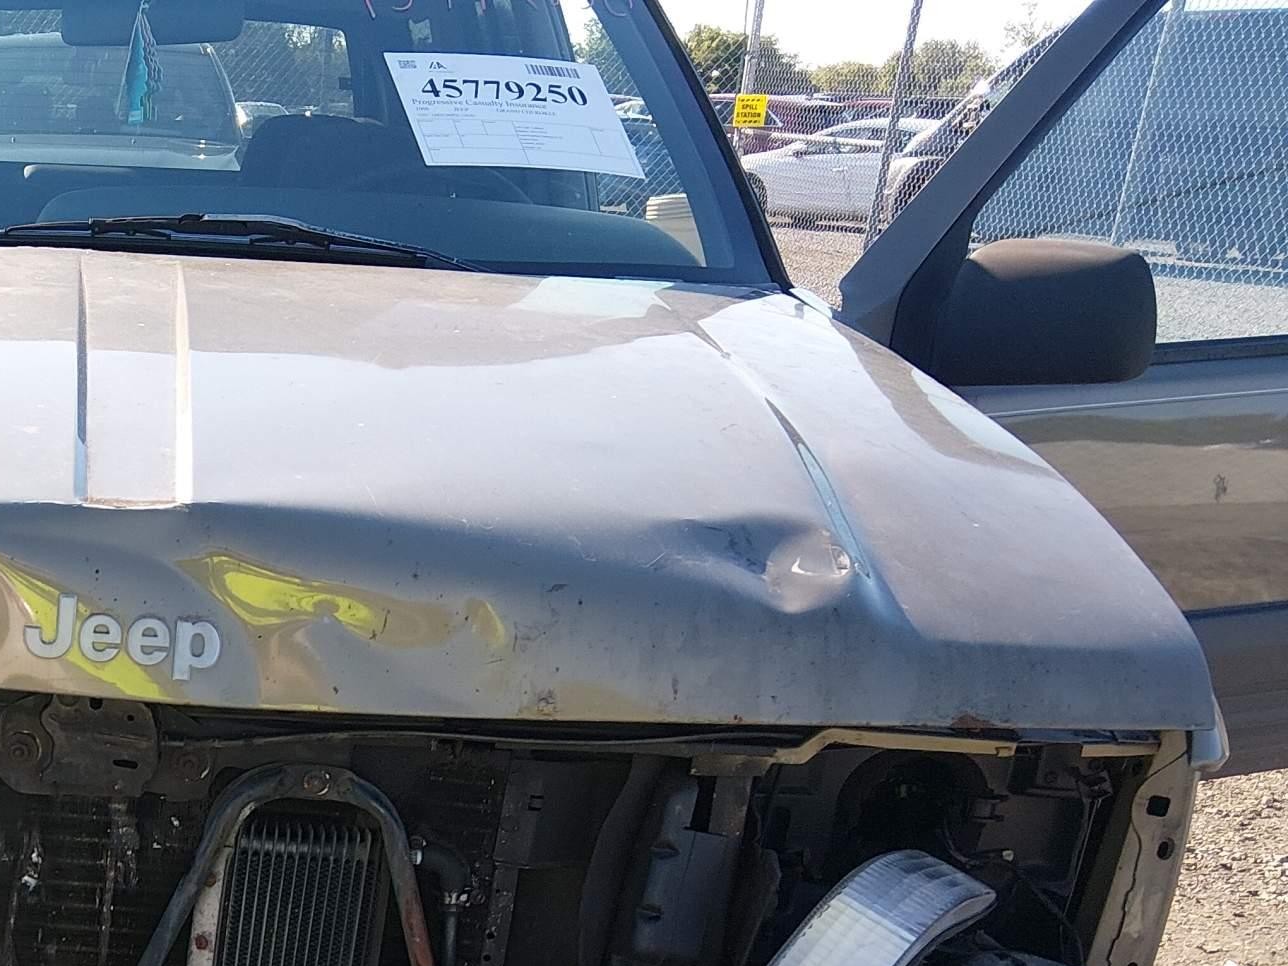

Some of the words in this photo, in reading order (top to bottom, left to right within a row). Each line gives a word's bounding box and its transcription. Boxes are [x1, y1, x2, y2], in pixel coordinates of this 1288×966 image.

[412, 98, 463, 106] Progressive
[465, 99, 503, 108] Casualty
[421, 78, 588, 106] 45779250
[24, 593, 221, 680] Jeep
